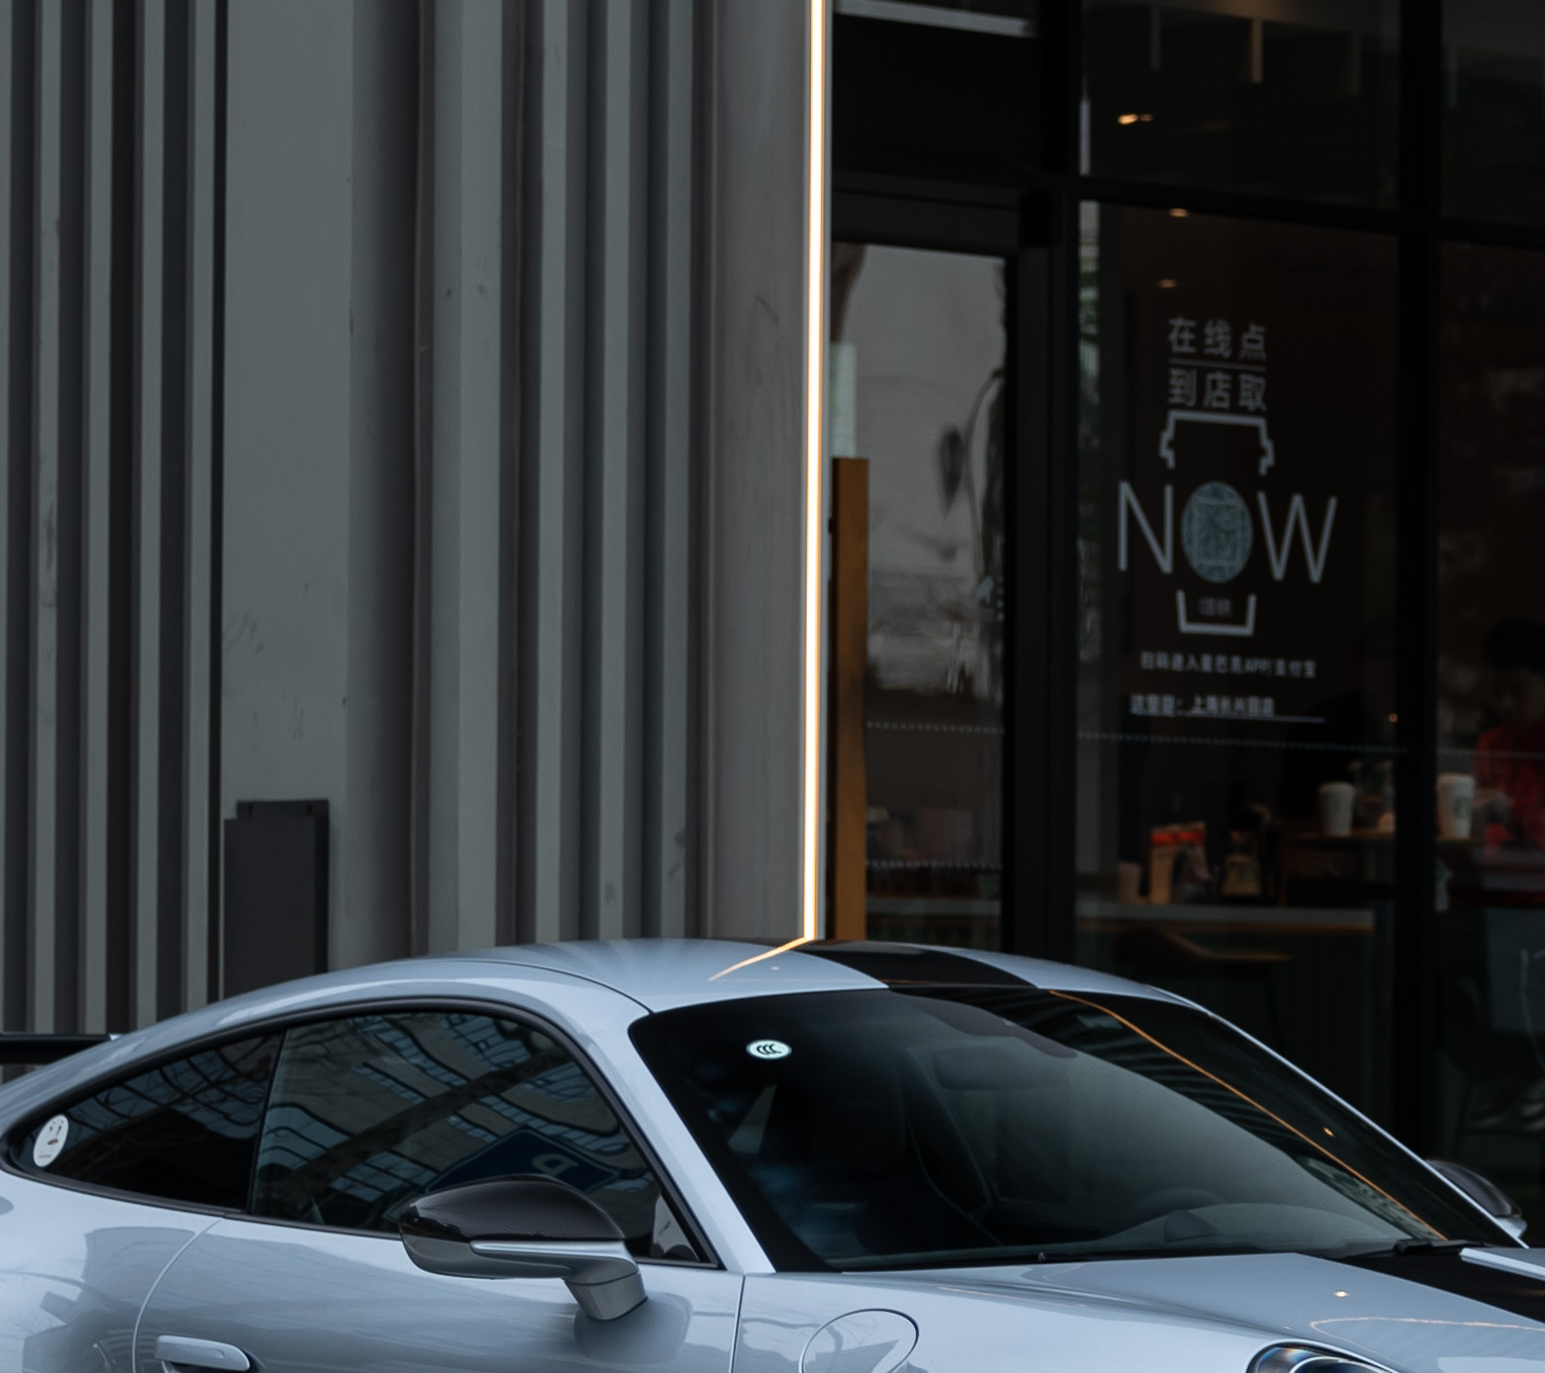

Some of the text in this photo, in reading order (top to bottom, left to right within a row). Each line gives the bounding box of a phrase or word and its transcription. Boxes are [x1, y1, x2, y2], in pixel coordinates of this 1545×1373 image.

[1167, 315, 1268, 362] 在线点
[1167, 368, 1268, 412] 到店取
